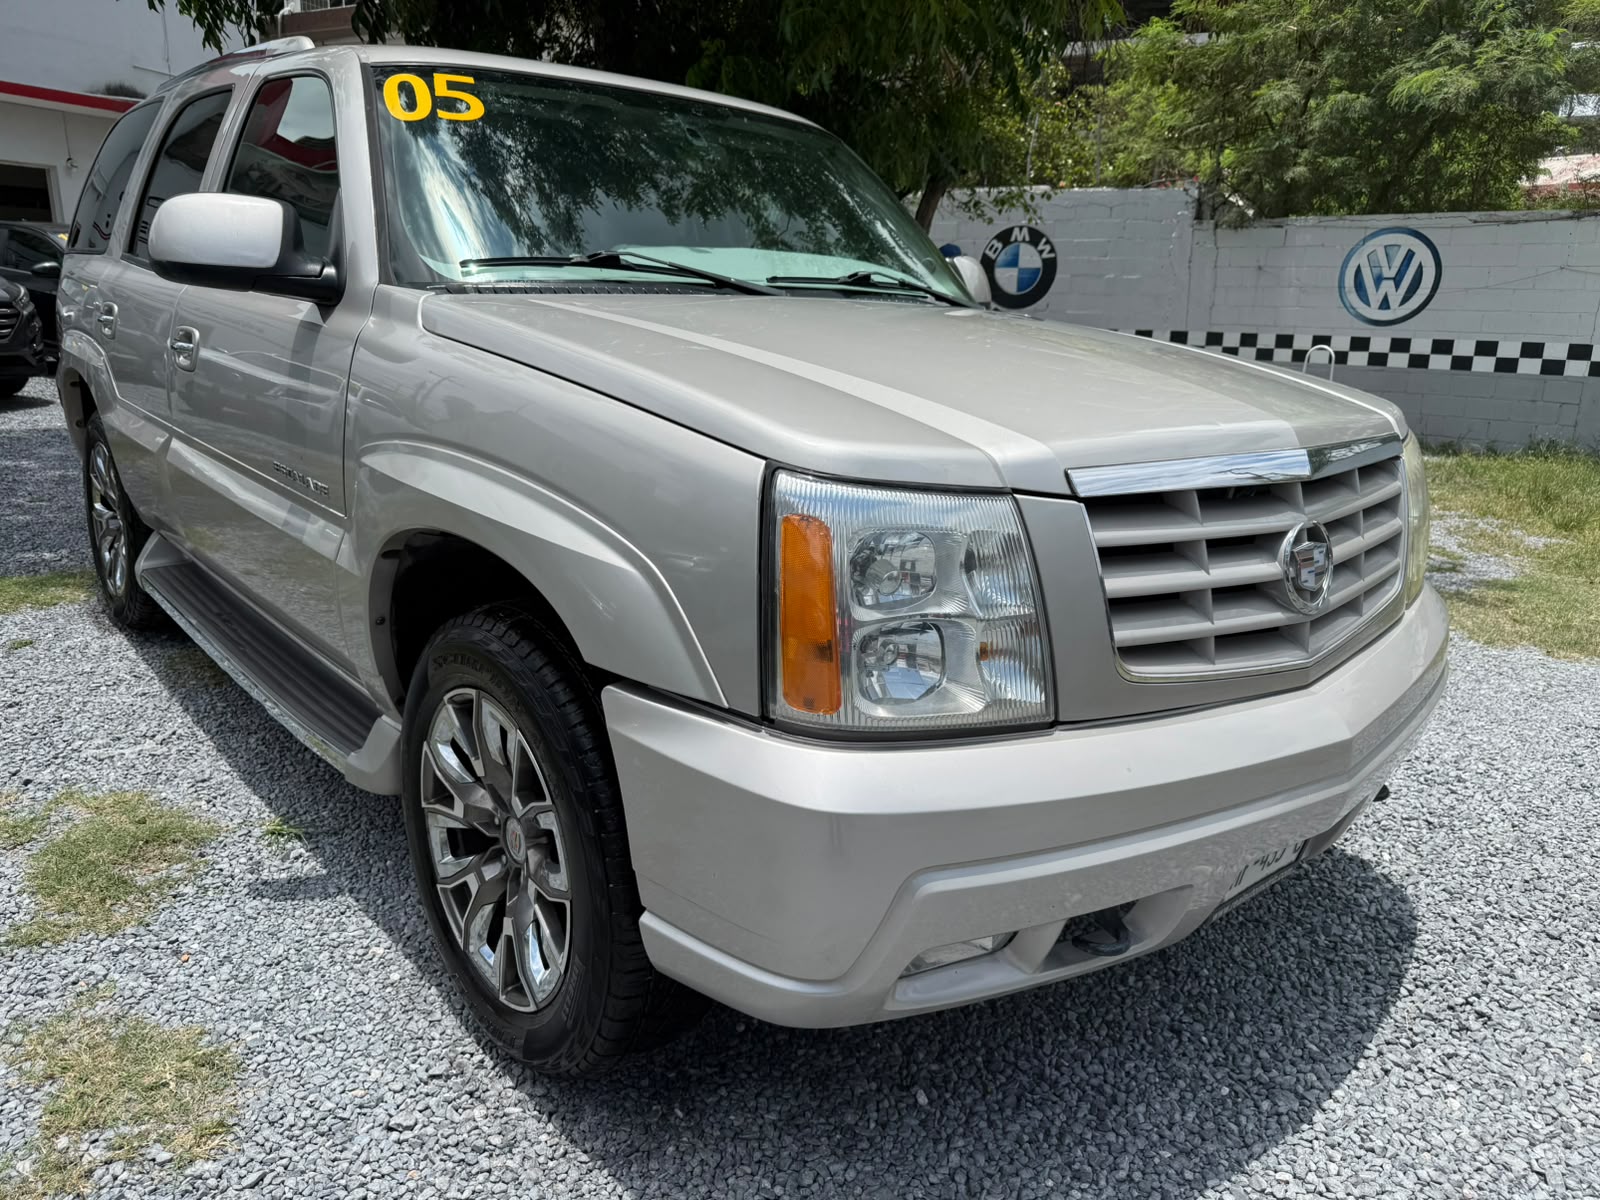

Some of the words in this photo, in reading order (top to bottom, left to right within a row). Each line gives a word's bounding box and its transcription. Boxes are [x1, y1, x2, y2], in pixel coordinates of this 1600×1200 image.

[383, 73, 485, 122] 05
[984, 226, 1056, 260] BMW
[1350, 238, 1428, 315] VW
